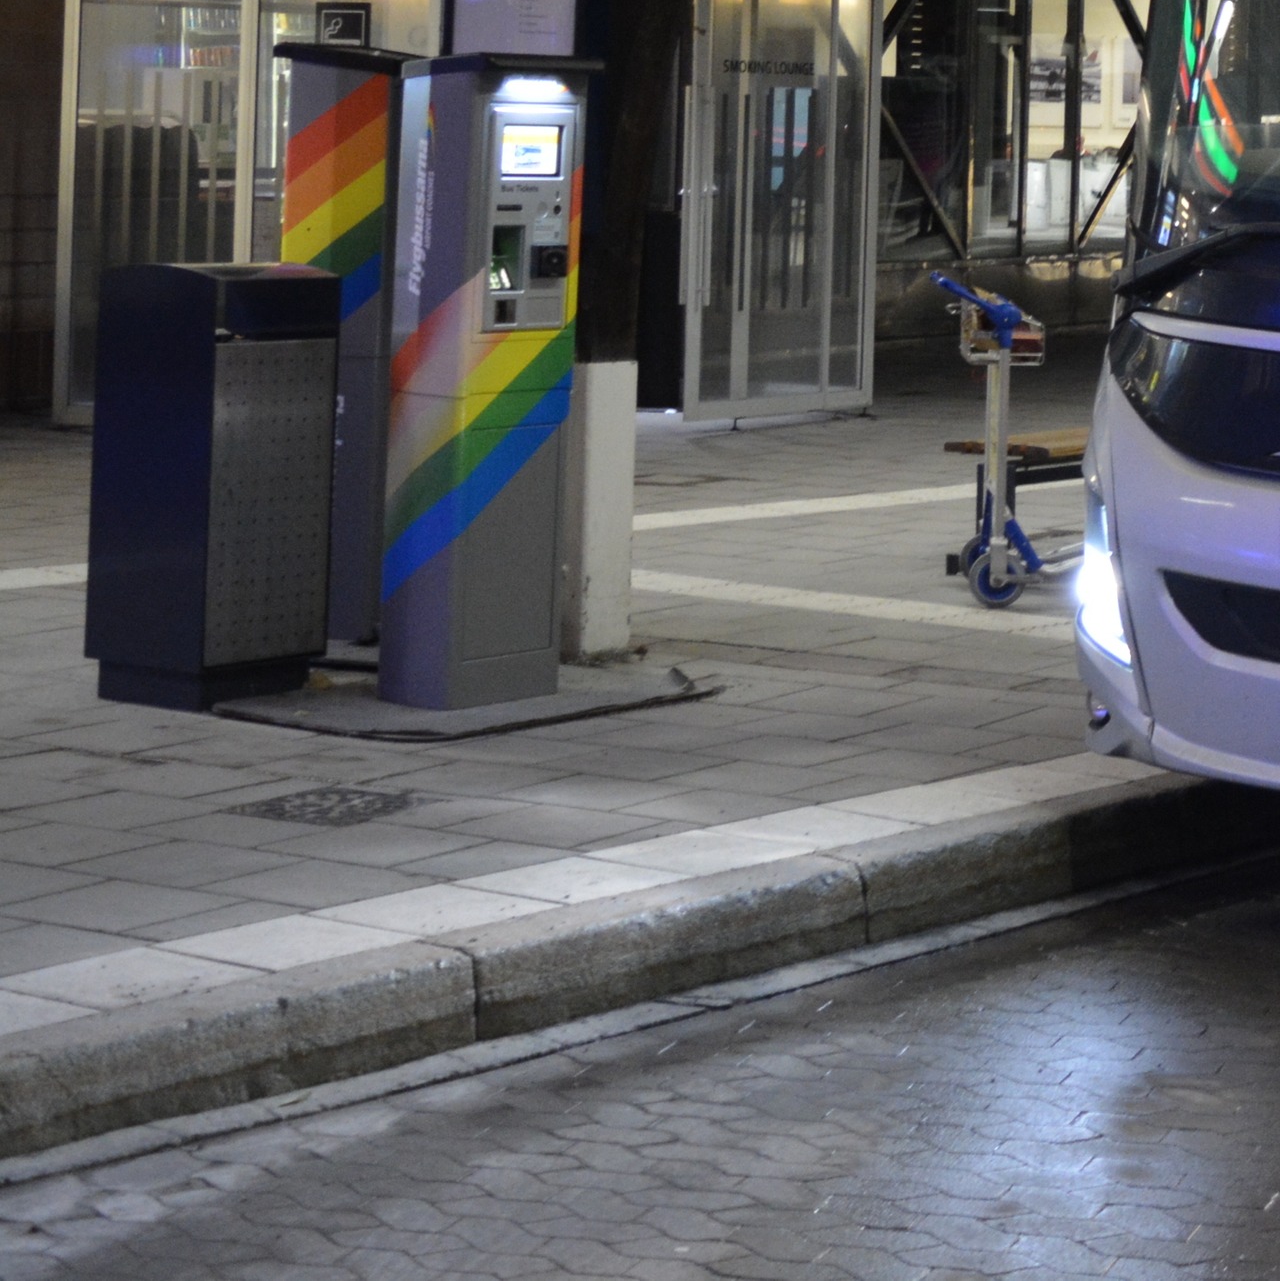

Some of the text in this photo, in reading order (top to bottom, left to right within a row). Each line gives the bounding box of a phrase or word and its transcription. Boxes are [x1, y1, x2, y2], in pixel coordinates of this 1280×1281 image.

[722, 59, 816, 76] SMOKING LOUNGE
[408, 137, 429, 297] Flygbussarna
